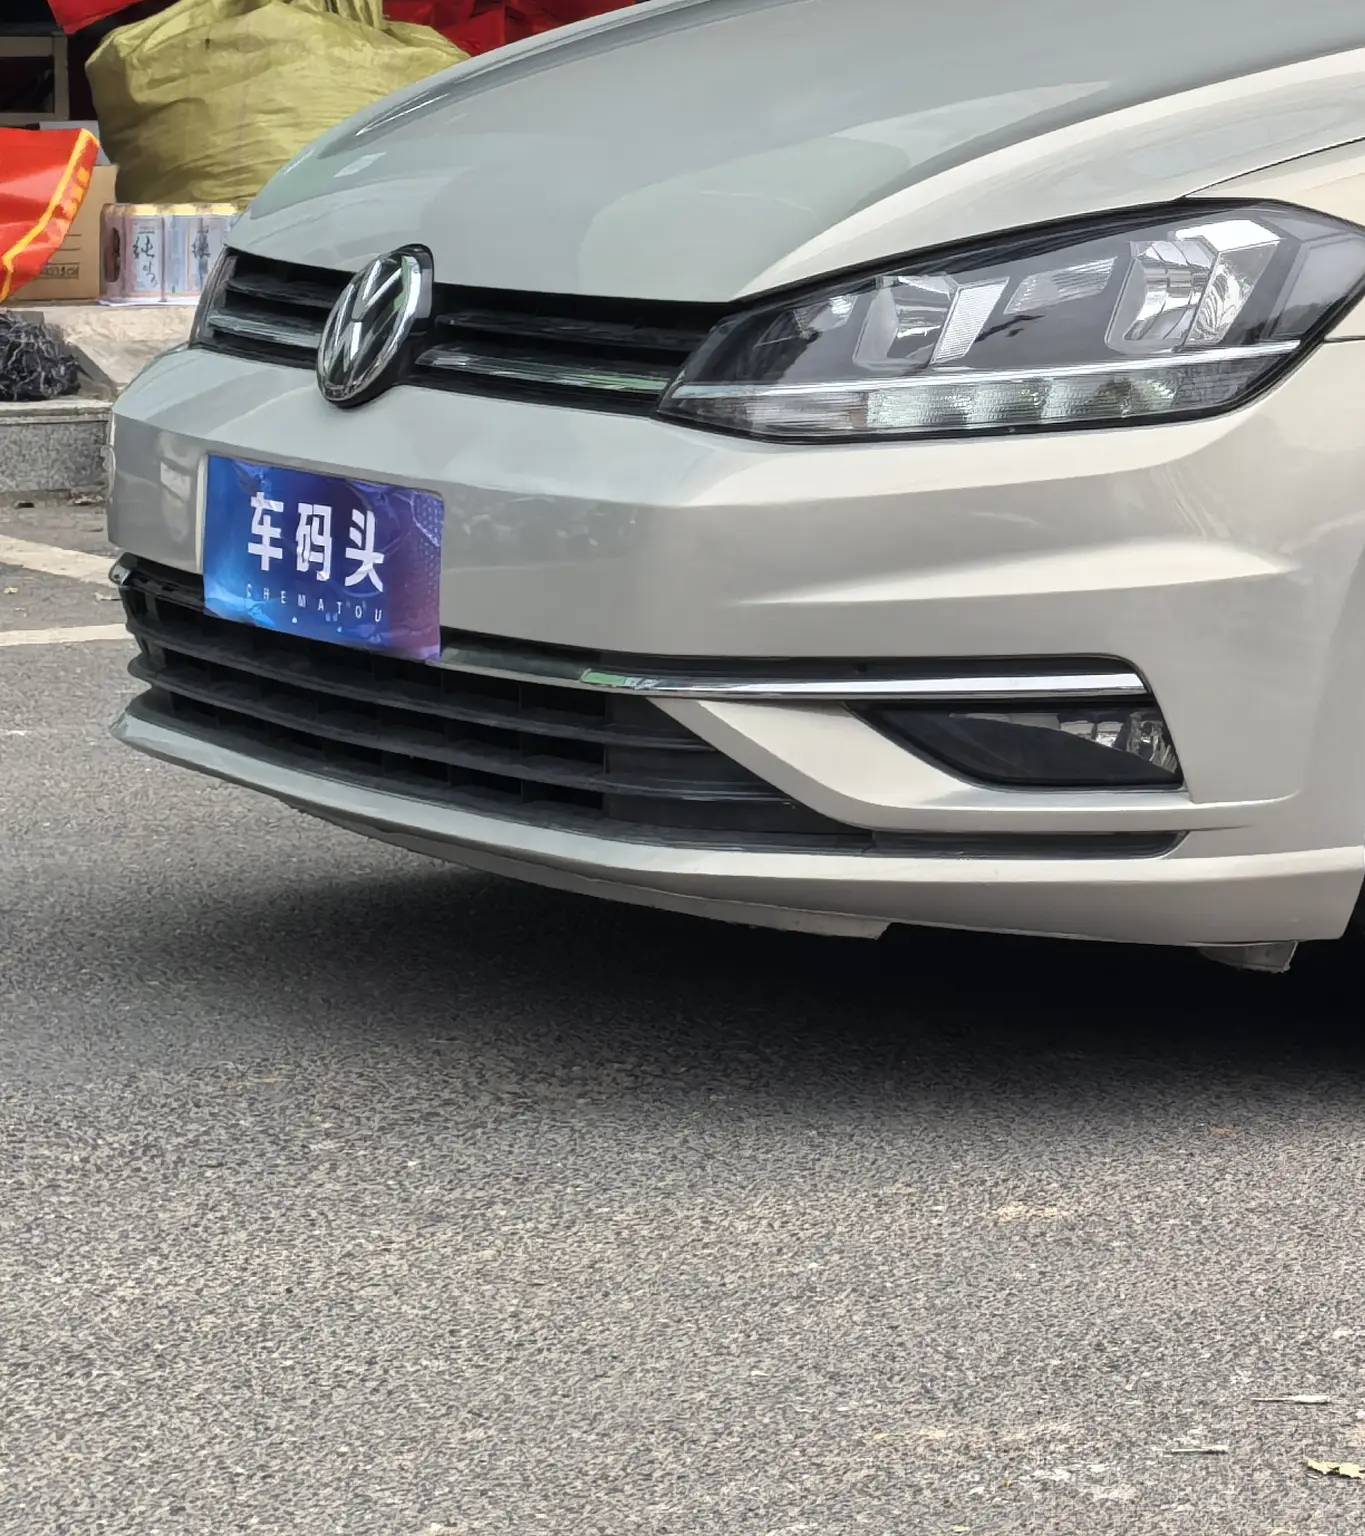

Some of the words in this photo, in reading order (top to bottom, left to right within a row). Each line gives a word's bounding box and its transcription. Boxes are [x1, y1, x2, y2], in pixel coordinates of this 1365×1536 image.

[248, 492, 385, 593] 车码头
[246, 583, 383, 622] CHEMATOU
